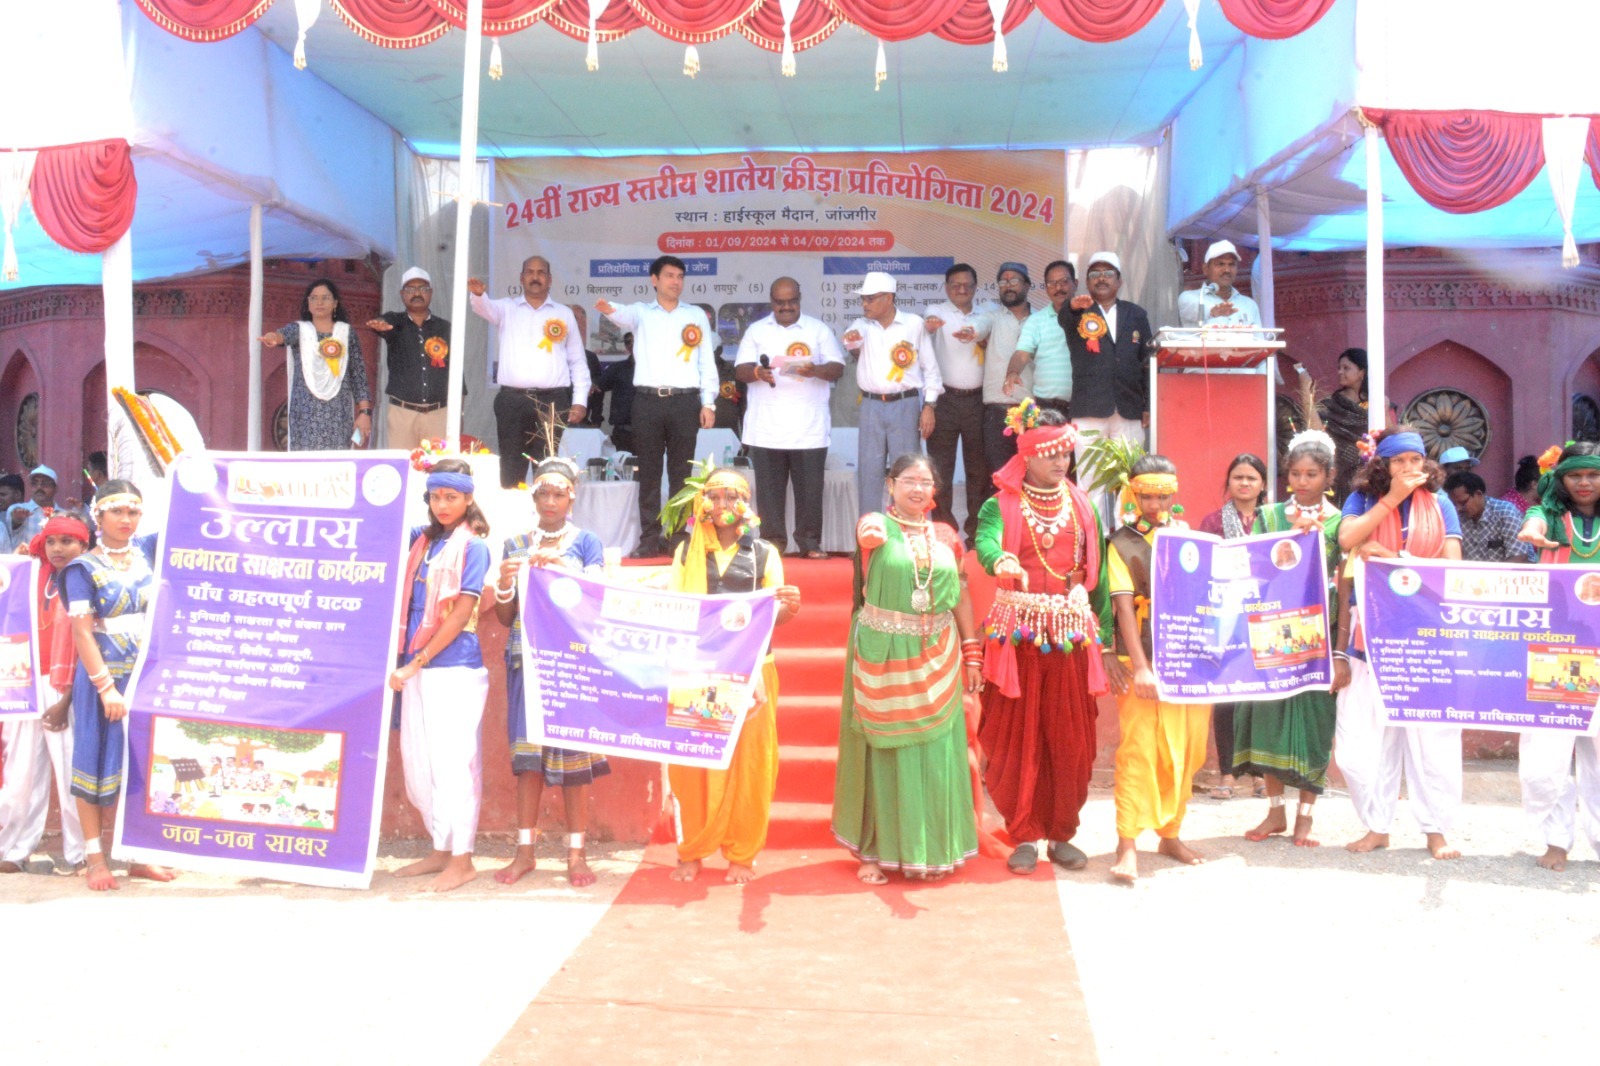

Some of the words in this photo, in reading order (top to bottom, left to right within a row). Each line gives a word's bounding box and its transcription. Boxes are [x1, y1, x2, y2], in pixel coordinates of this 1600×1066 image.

[506, 183, 562, 229] 24वीं
[567, 183, 620, 214] राज्य
[626, 165, 697, 203] स्तरीय
[704, 156, 776, 193] शालेय
[782, 156, 842, 197] क्रीड़ा
[847, 160, 984, 209] प्रतियोगिता
[990, 186, 1053, 224] 2024
[675, 211, 708, 223] स्थान
[723, 206, 776, 225] हाईस्कूल
[782, 205, 819, 223] मैदान,
[825, 206, 877, 222] जांजगीर
[666, 236, 694, 248] दिनांक
[706, 237, 777, 248] 01/09/2024
[780, 235, 790, 247] से
[793, 236, 865, 247] 04/09/2024
[869, 237, 886, 247] तक
[598, 262, 640, 273] प्रतियोगिता
[692, 262, 710, 272] जोन
[866, 261, 911, 272] प्रतियोगिता
[507, 285, 523, 295] (1)
[564, 285, 580, 296] (2)
[587, 284, 623, 297] बिलासपुर
[633, 285, 649, 296] (3)
[692, 284, 707, 294] (4)
[714, 284, 738, 295] रायपुर
[749, 283, 764, 294] (5)
[821, 282, 837, 292] (1)
[821, 298, 837, 308] (2)
[821, 314, 837, 324] (3)
[201, 507, 363, 548] उल्लास
[169, 547, 239, 573] नवभारत
[242, 553, 314, 581] साक्षरता
[317, 552, 387, 585] कार्यक्रम
[187, 581, 223, 602] पाँच
[228, 587, 312, 613] महत्वपूर्ण
[316, 595, 362, 612] घटक
[1439, 602, 1553, 629] उल्लास
[1417, 628, 1437, 638] नव
[1472, 629, 1520, 642] साक्षरता
[1523, 630, 1576, 645] कार्यक्रम
[1403, 708, 1442, 719] साक्षरता
[1446, 706, 1474, 720] मिशन
[1539, 711, 1590, 726] जांजगीर-
[547, 724, 585, 738] साक्षरता
[588, 726, 617, 743] मिशन
[675, 738, 724, 756] जांजगीर-
[161, 823, 256, 850] जन-जन
[265, 834, 329, 857] साक्षर
